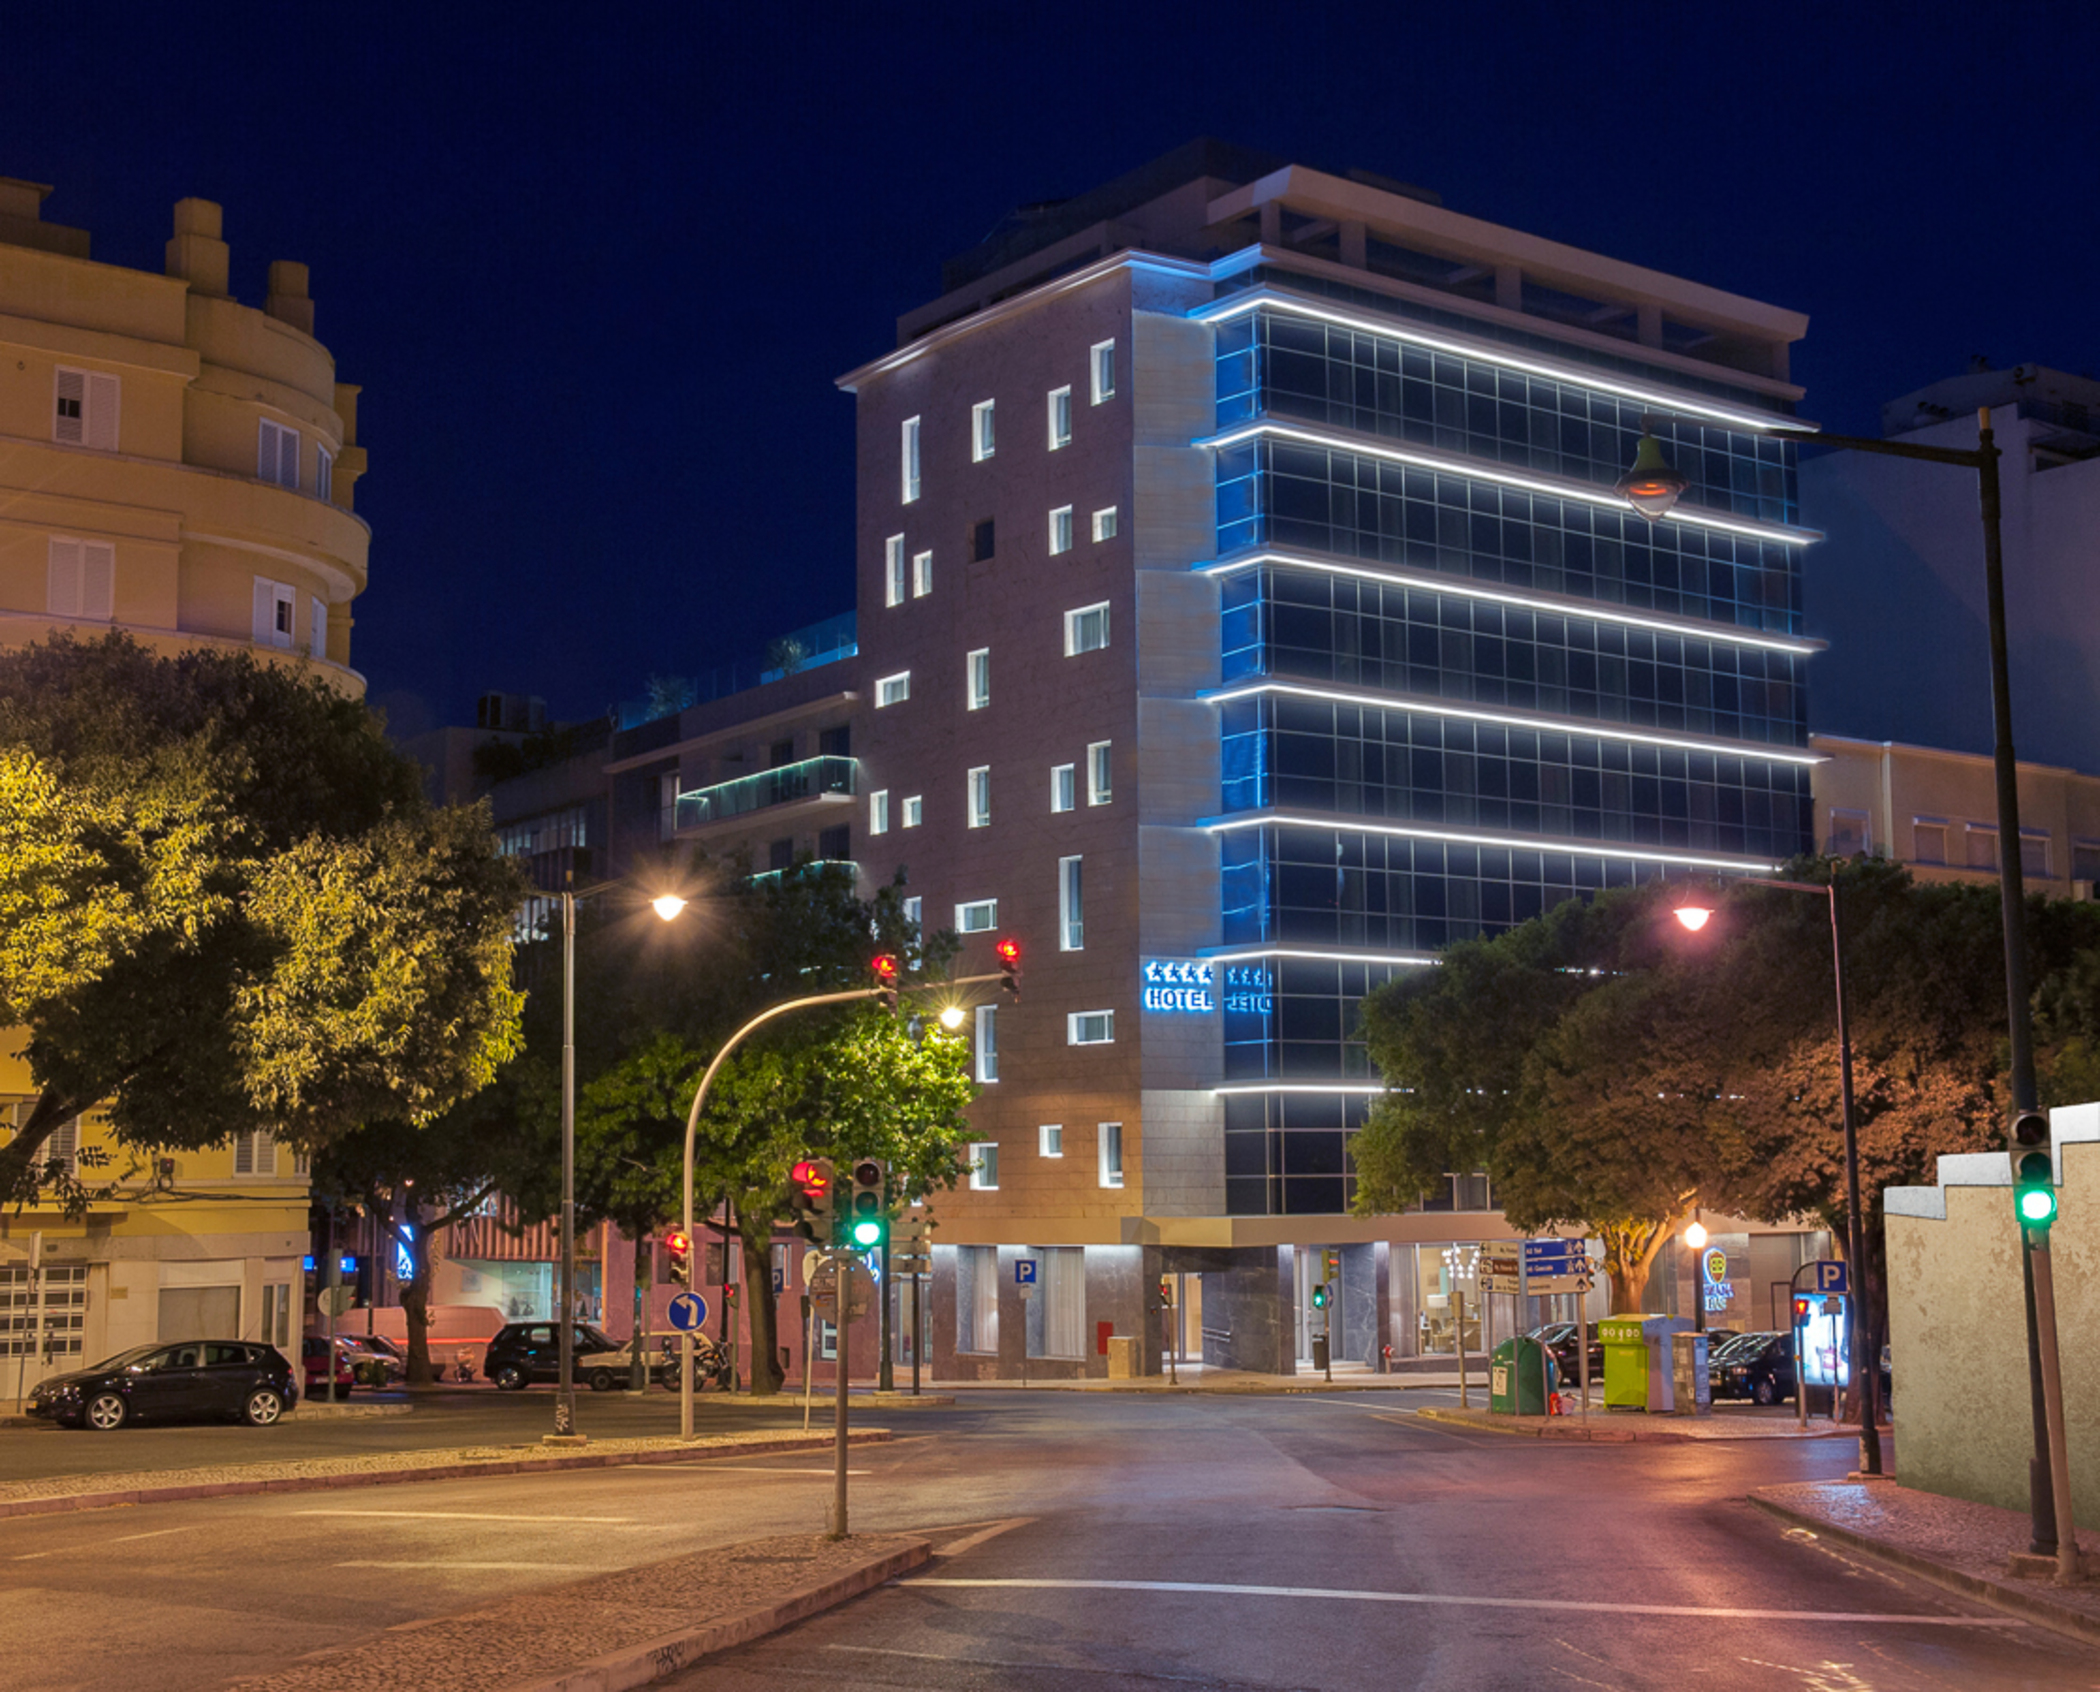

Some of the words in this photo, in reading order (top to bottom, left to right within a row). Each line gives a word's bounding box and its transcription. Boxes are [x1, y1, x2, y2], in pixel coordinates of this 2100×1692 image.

[1146, 988, 1214, 1010] HOTEL
[1019, 1263, 1032, 1281] P
[1823, 1265, 1841, 1288] P
